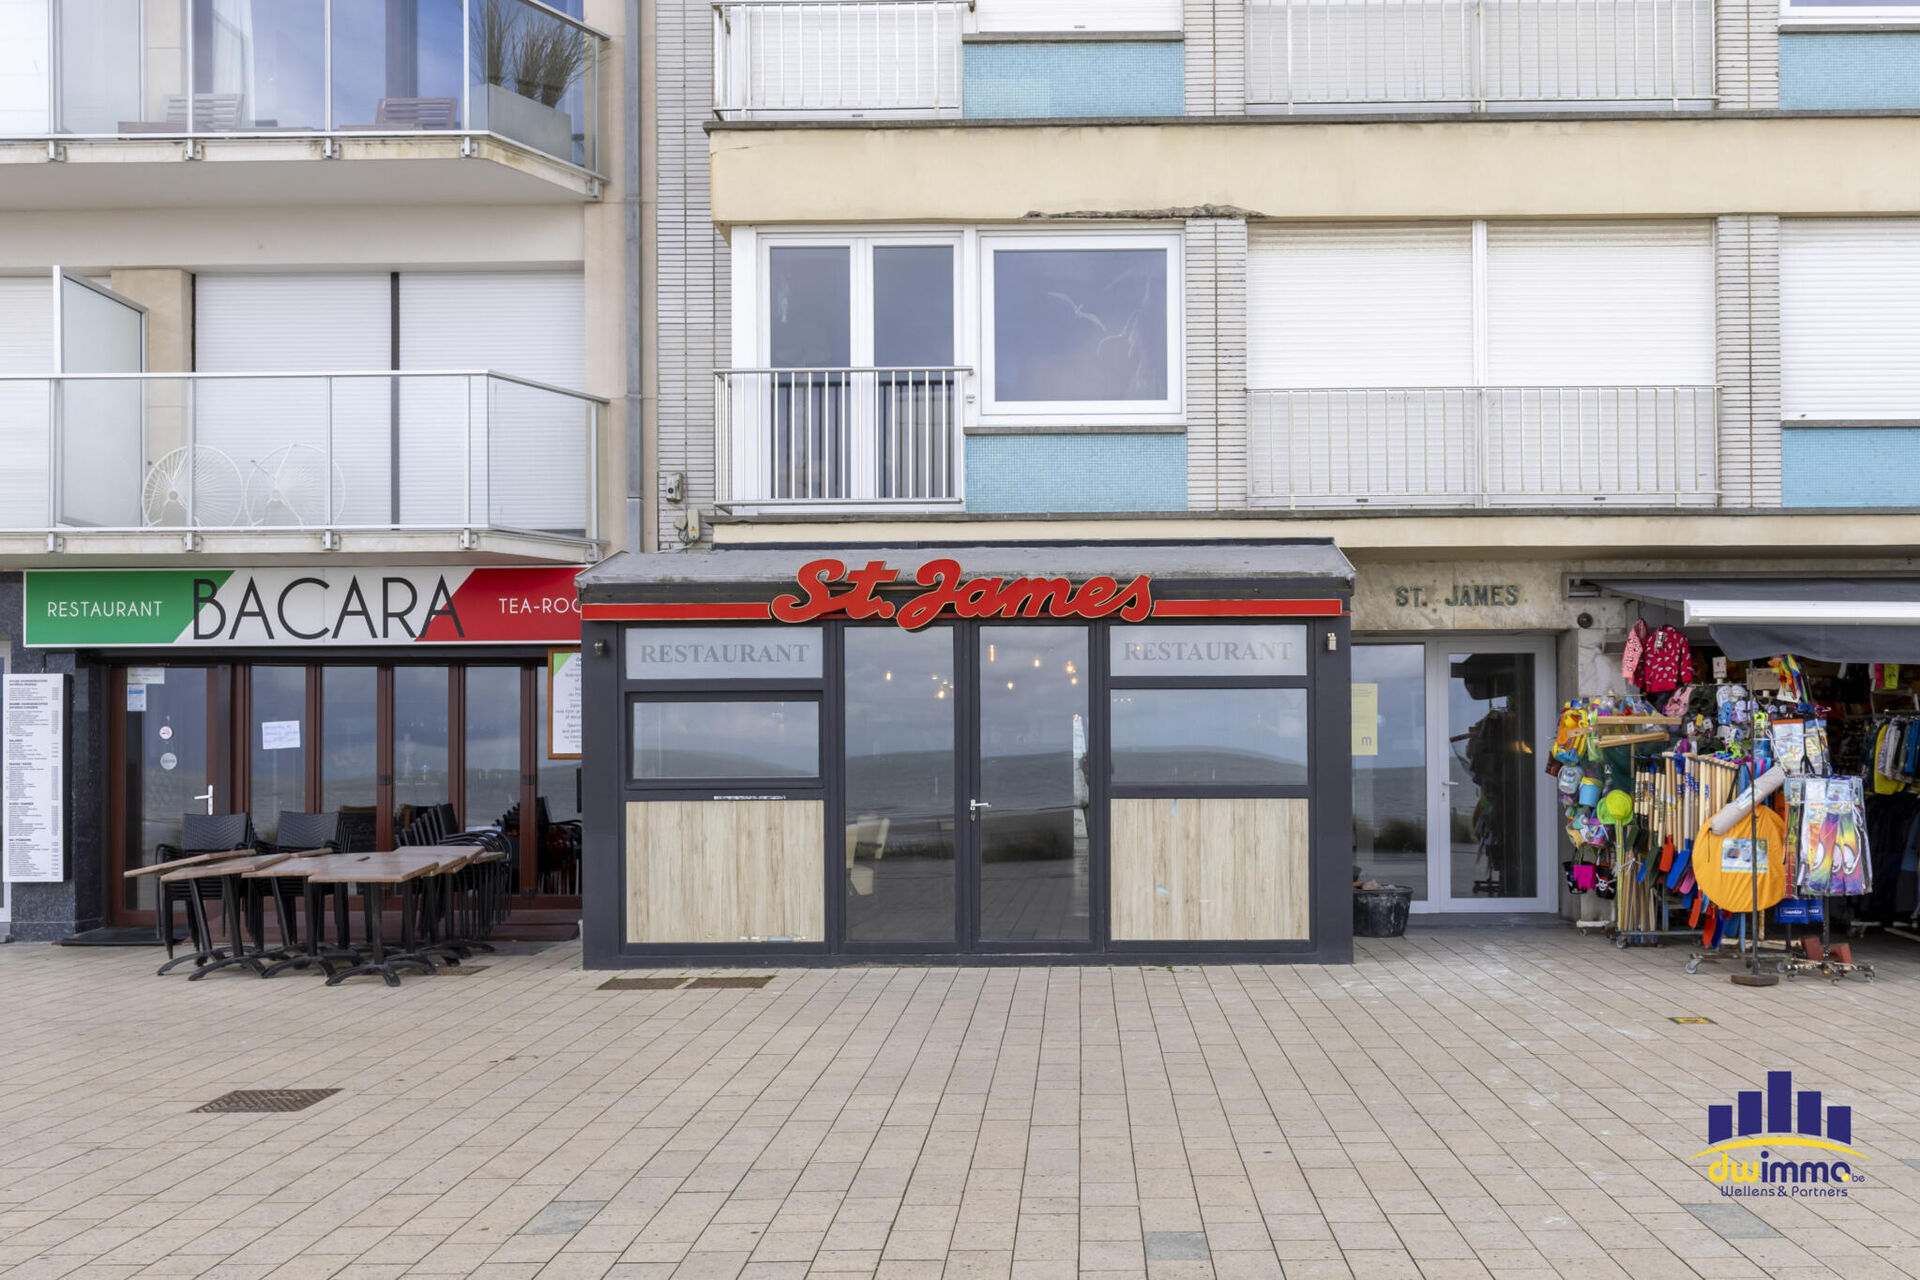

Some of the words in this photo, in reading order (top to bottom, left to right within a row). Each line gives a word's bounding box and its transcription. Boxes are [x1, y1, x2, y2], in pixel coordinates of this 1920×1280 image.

[771, 558, 899, 624] St.
[896, 558, 1153, 631] James
[1395, 585, 1428, 607] ST.
[1444, 585, 1519, 607] JAMES
[47, 601, 163, 618] RESTAURANT
[193, 575, 466, 640] BACARA
[640, 643, 810, 664] RESTAURANT
[1123, 641, 1294, 662] RESTAURANT
